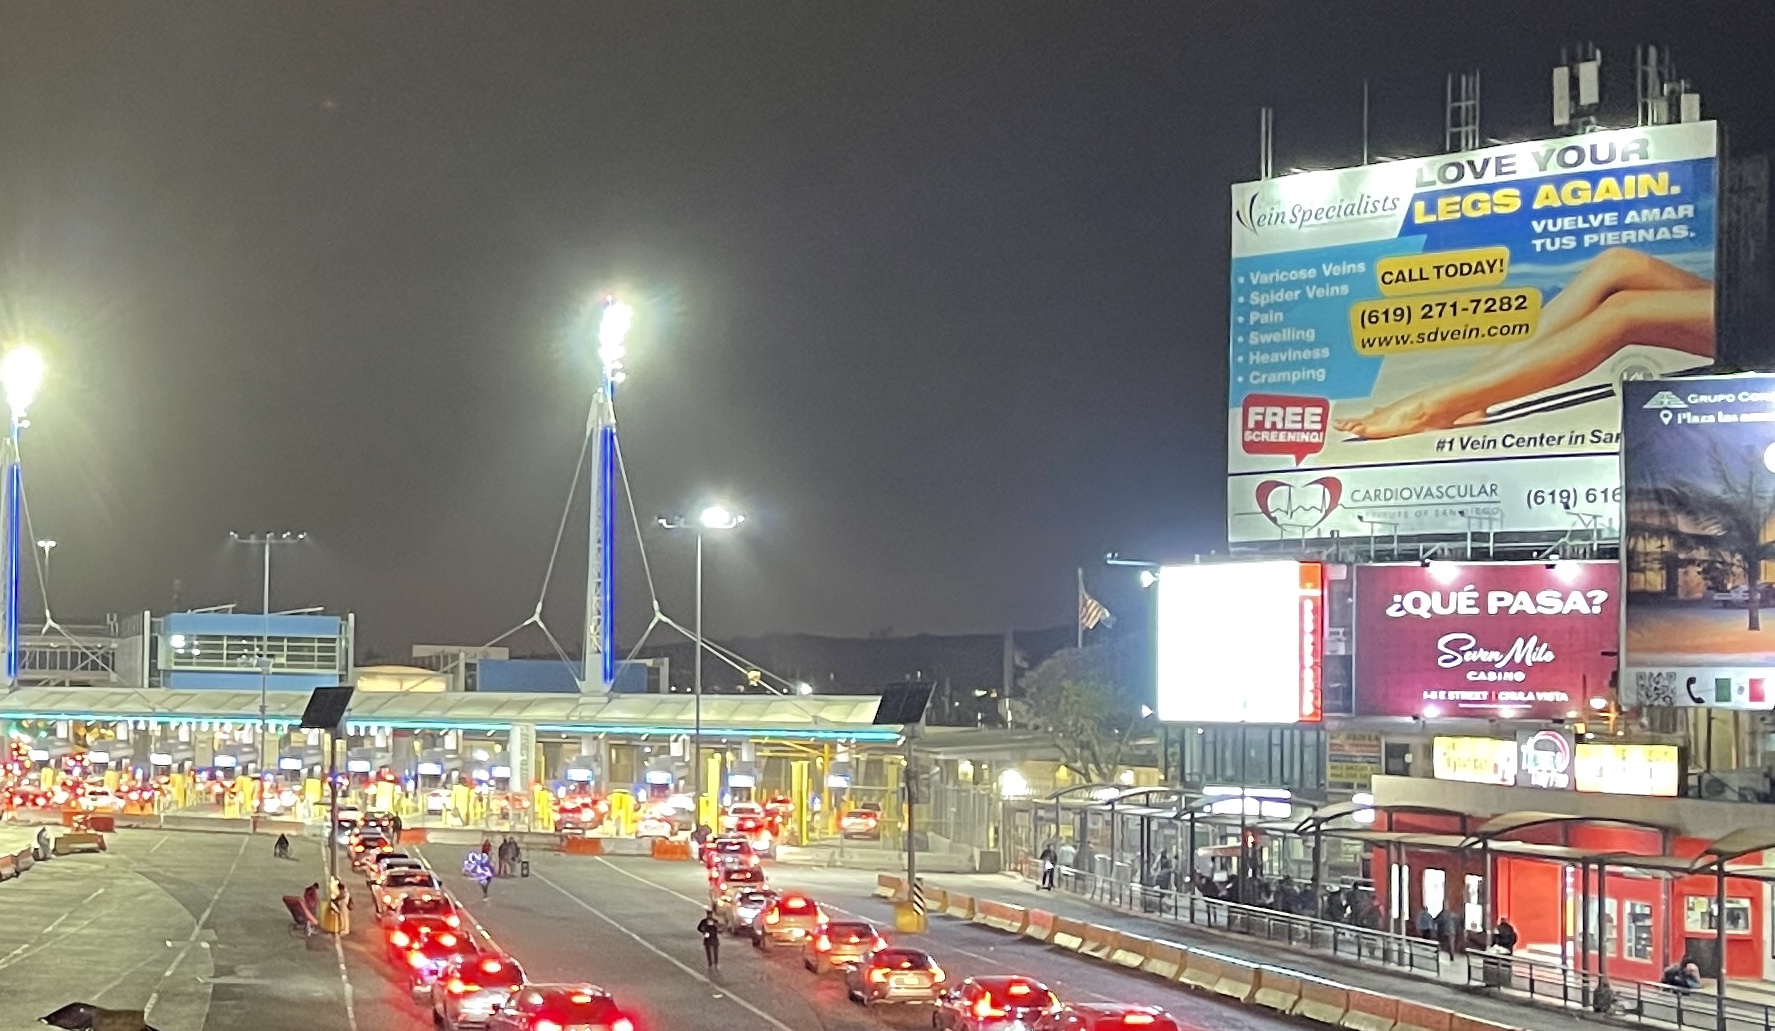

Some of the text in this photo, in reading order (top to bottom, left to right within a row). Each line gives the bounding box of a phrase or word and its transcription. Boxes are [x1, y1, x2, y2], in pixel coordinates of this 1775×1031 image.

[1415, 138, 1650, 188] LOVE YOUR
[1413, 172, 1681, 224] LEGS AGAIN.
[1289, 193, 1400, 230] Specialists
[1531, 204, 1694, 233] VUELVE AMAR
[1531, 225, 1697, 252] TUS PIERNAS.
[1249, 261, 1366, 285] Varicose Veins
[1381, 258, 1505, 286] CALL TODAY!
[1249, 283, 1350, 307] Spider Veins
[1249, 310, 1284, 325] Pain
[1360, 295, 1528, 329] (619) 271-7282
[1249, 328, 1316, 346] Swelling
[1361, 322, 1530, 349] www.sdvein.com
[1249, 346, 1330, 365] Heaviness
[1249, 367, 1326, 384] Cramping
[1247, 406, 1323, 430] FREE
[1244, 430, 1323, 443] SCREENING!
[1435, 437, 1454, 452] #1
[1459, 435, 1497, 451] Vein
[1501, 432, 1565, 448] Center
[1569, 430, 1585, 445] in
[1350, 483, 1498, 502] CARDIOVASCULAR
[1526, 487, 1578, 508] (619)
[1385, 584, 1609, 619] ¿QUÉ PASA?
[1466, 671, 1526, 682] CASINO
